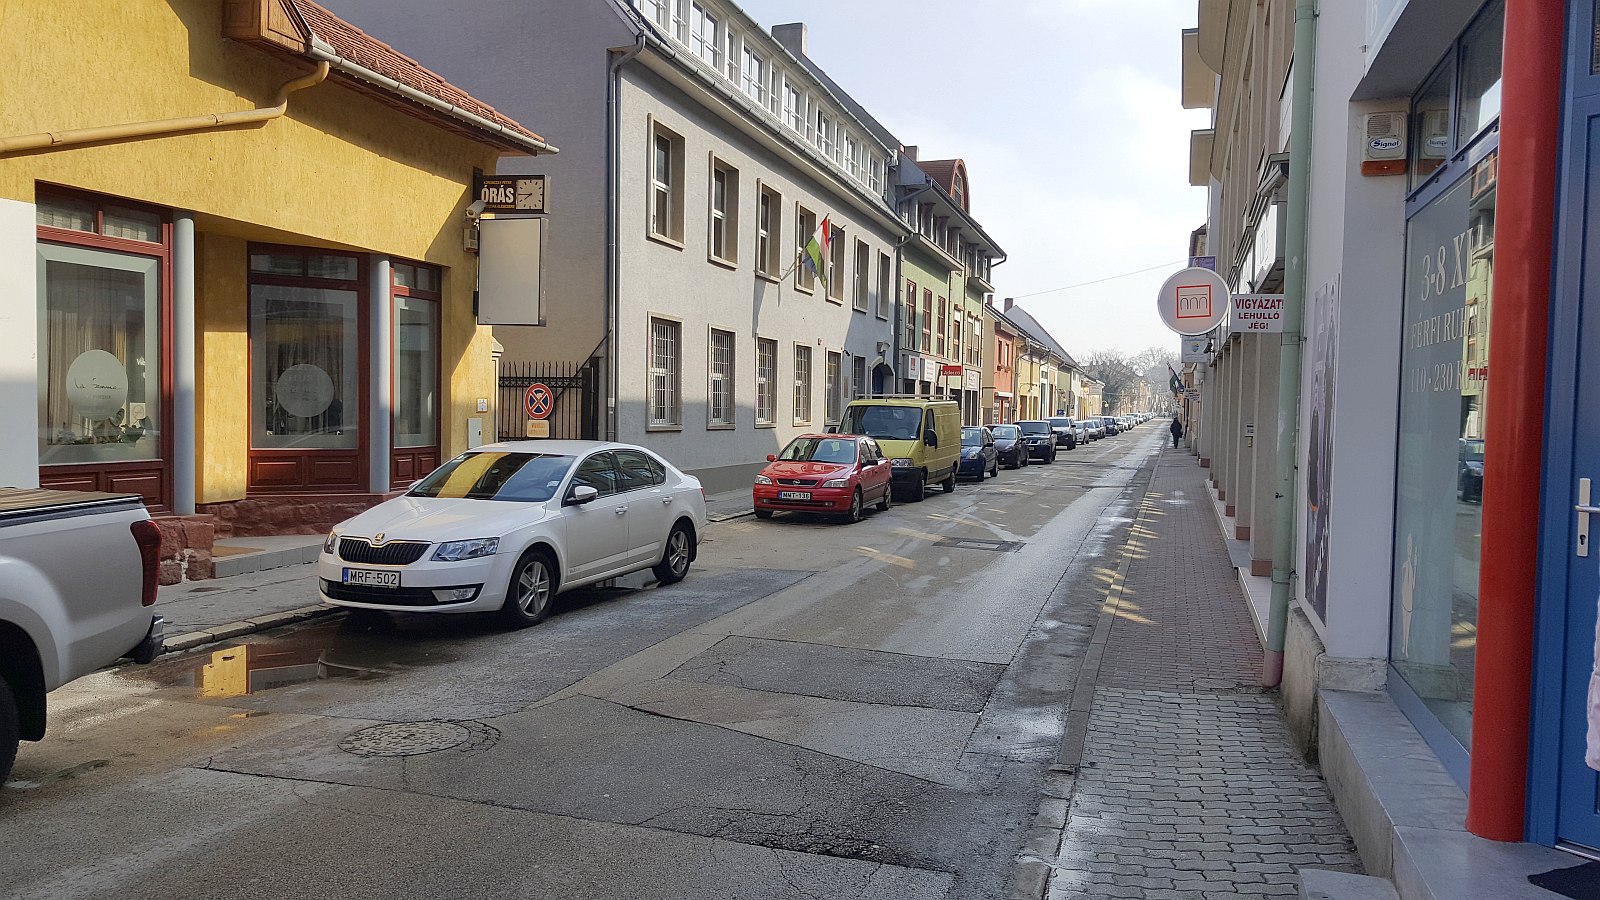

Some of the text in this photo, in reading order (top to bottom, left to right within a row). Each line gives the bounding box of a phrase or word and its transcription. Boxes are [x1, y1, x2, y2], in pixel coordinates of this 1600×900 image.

[1373, 139, 1399, 149] Signal
[481, 185, 514, 203] ÓRÁS
[1421, 227, 1477, 301] 3-8 XL
[1235, 297, 1284, 309] VIGYÁZAT!
[1238, 311, 1280, 320] LEHULLÓ
[1247, 321, 1269, 330] JÉG!
[1411, 313, 1441, 349] FÉRFI
[1411, 366, 1427, 393] 110
[1433, 362, 1453, 392] 230
[350, 571, 397, 584] MRF-502
